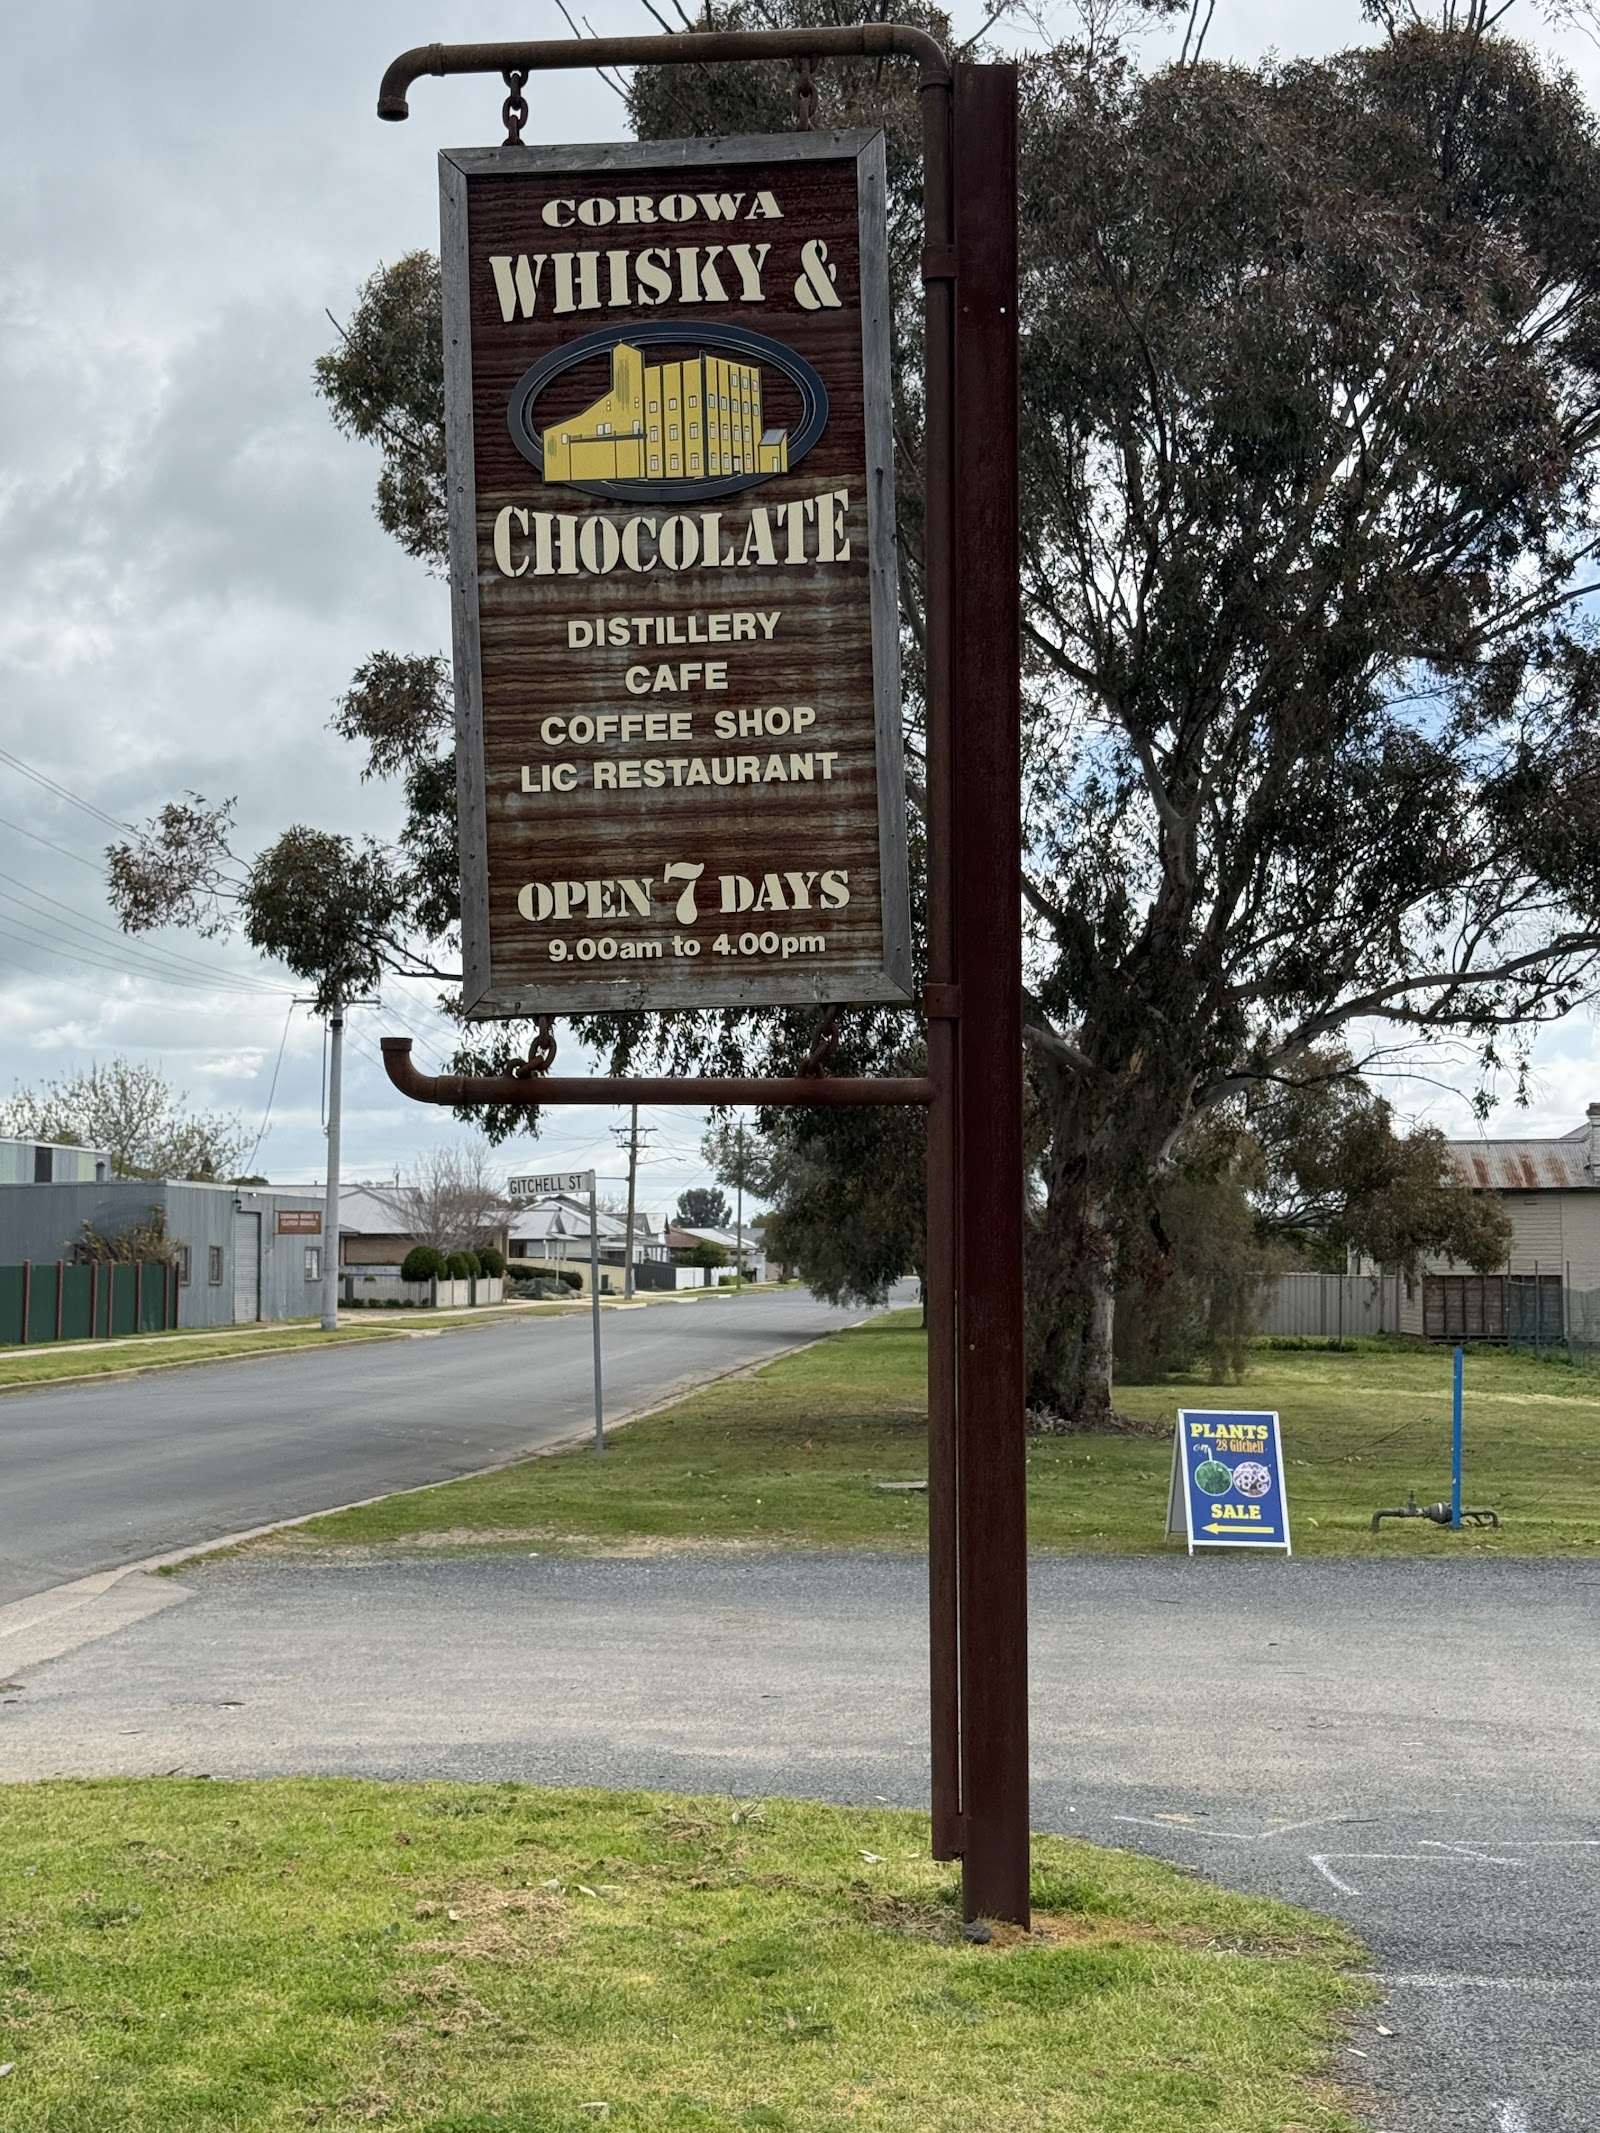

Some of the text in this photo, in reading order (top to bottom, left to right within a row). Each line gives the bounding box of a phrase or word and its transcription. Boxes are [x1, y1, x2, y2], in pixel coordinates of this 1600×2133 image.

[541, 191, 784, 227] COROWA
[489, 239, 842, 322] WHISKY &
[493, 488, 851, 577] CHOCOLATE
[568, 612, 781, 648] DISTILLERY
[625, 662, 728, 694] CAFE
[540, 707, 816, 746] COFFEE SHOP
[521, 752, 838, 792] LIC RESTAURANT
[517, 862, 850, 925] OPEN 7 DAYS
[548, 931, 826, 962] 9.00am to 4.00pm
[510, 1175, 582, 1194] GITCHELL ST
[1190, 1423, 1268, 1440] PLANTS
[1216, 1439, 1227, 1451] 28
[1230, 1440, 1264, 1453] Gitchell
[1211, 1503, 1262, 1519] SALE
